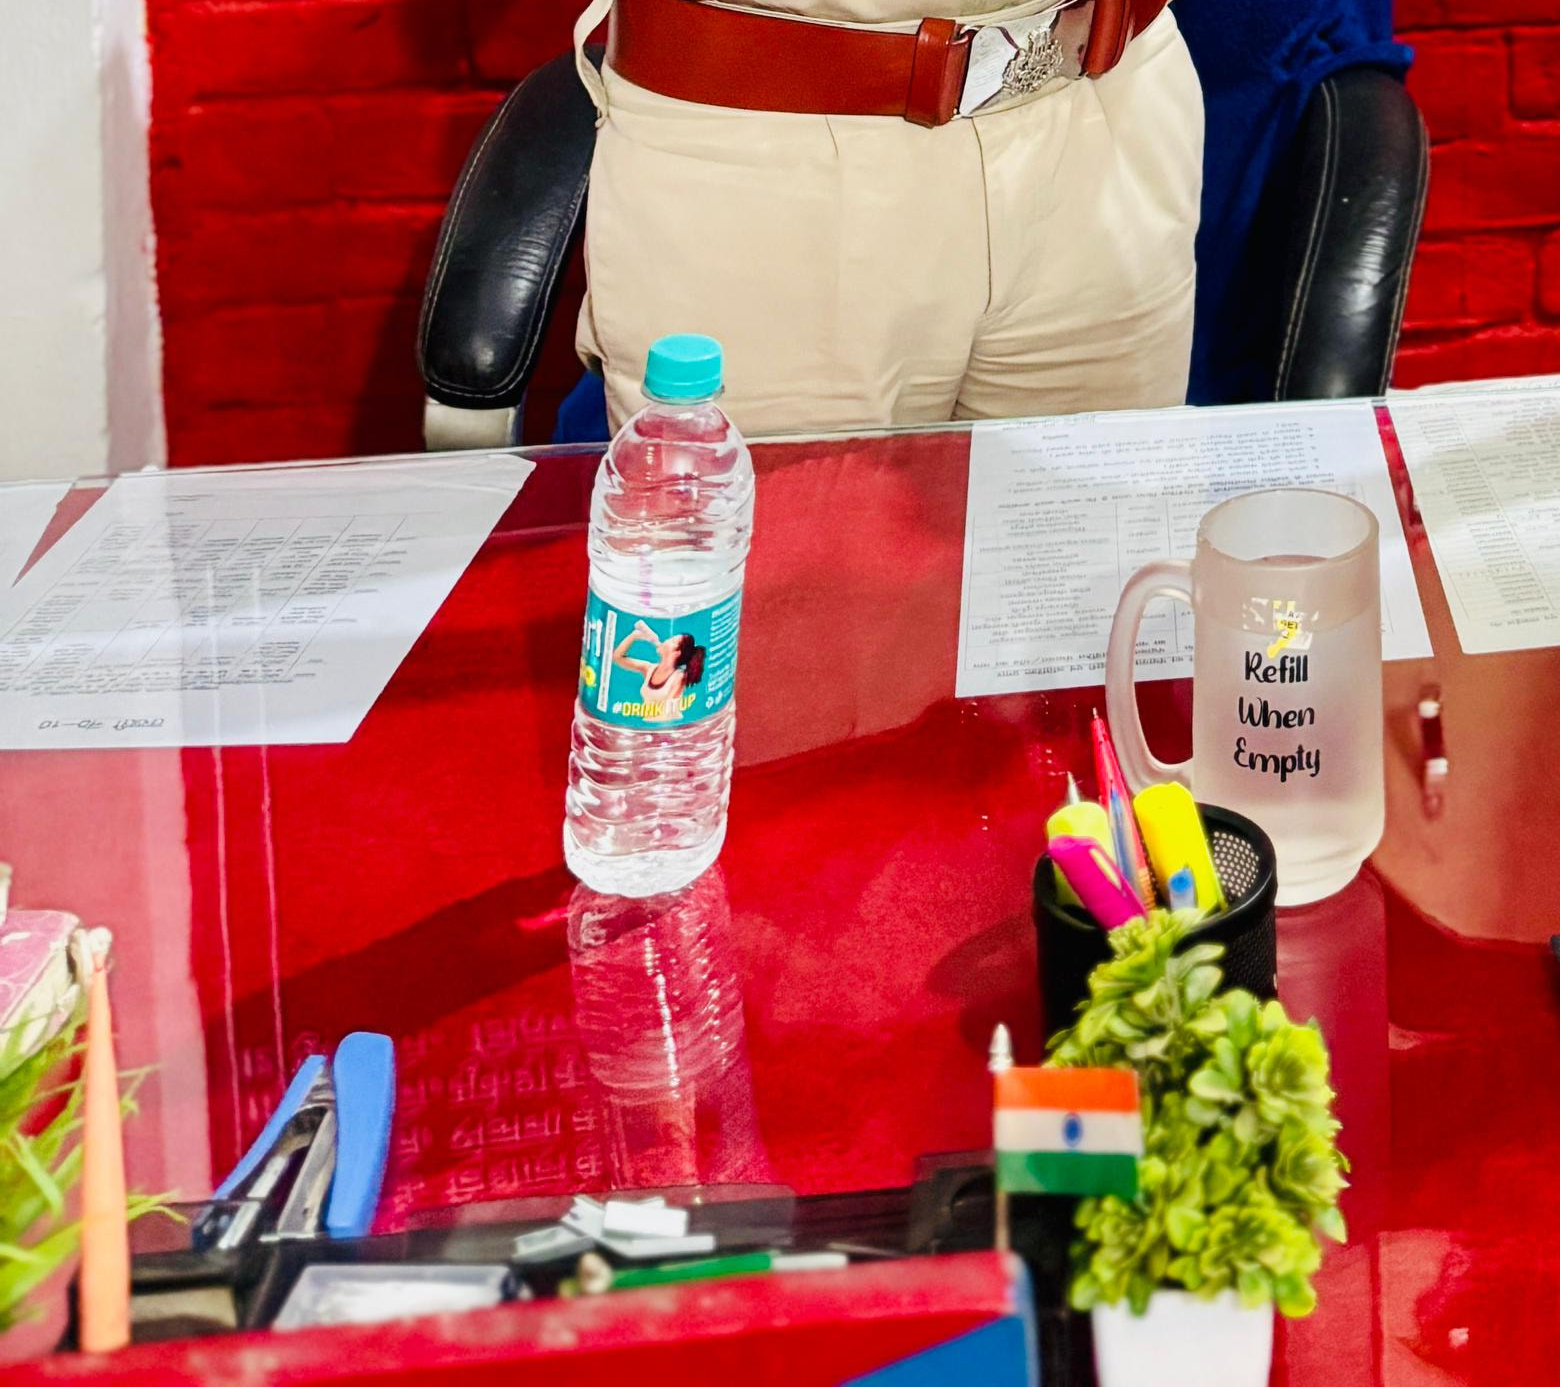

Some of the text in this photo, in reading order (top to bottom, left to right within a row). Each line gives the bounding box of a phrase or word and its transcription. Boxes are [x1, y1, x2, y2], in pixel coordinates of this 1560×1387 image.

[1244, 650, 1309, 684] Refill
[1238, 696, 1315, 729] When
[1233, 736, 1321, 783] Empty
